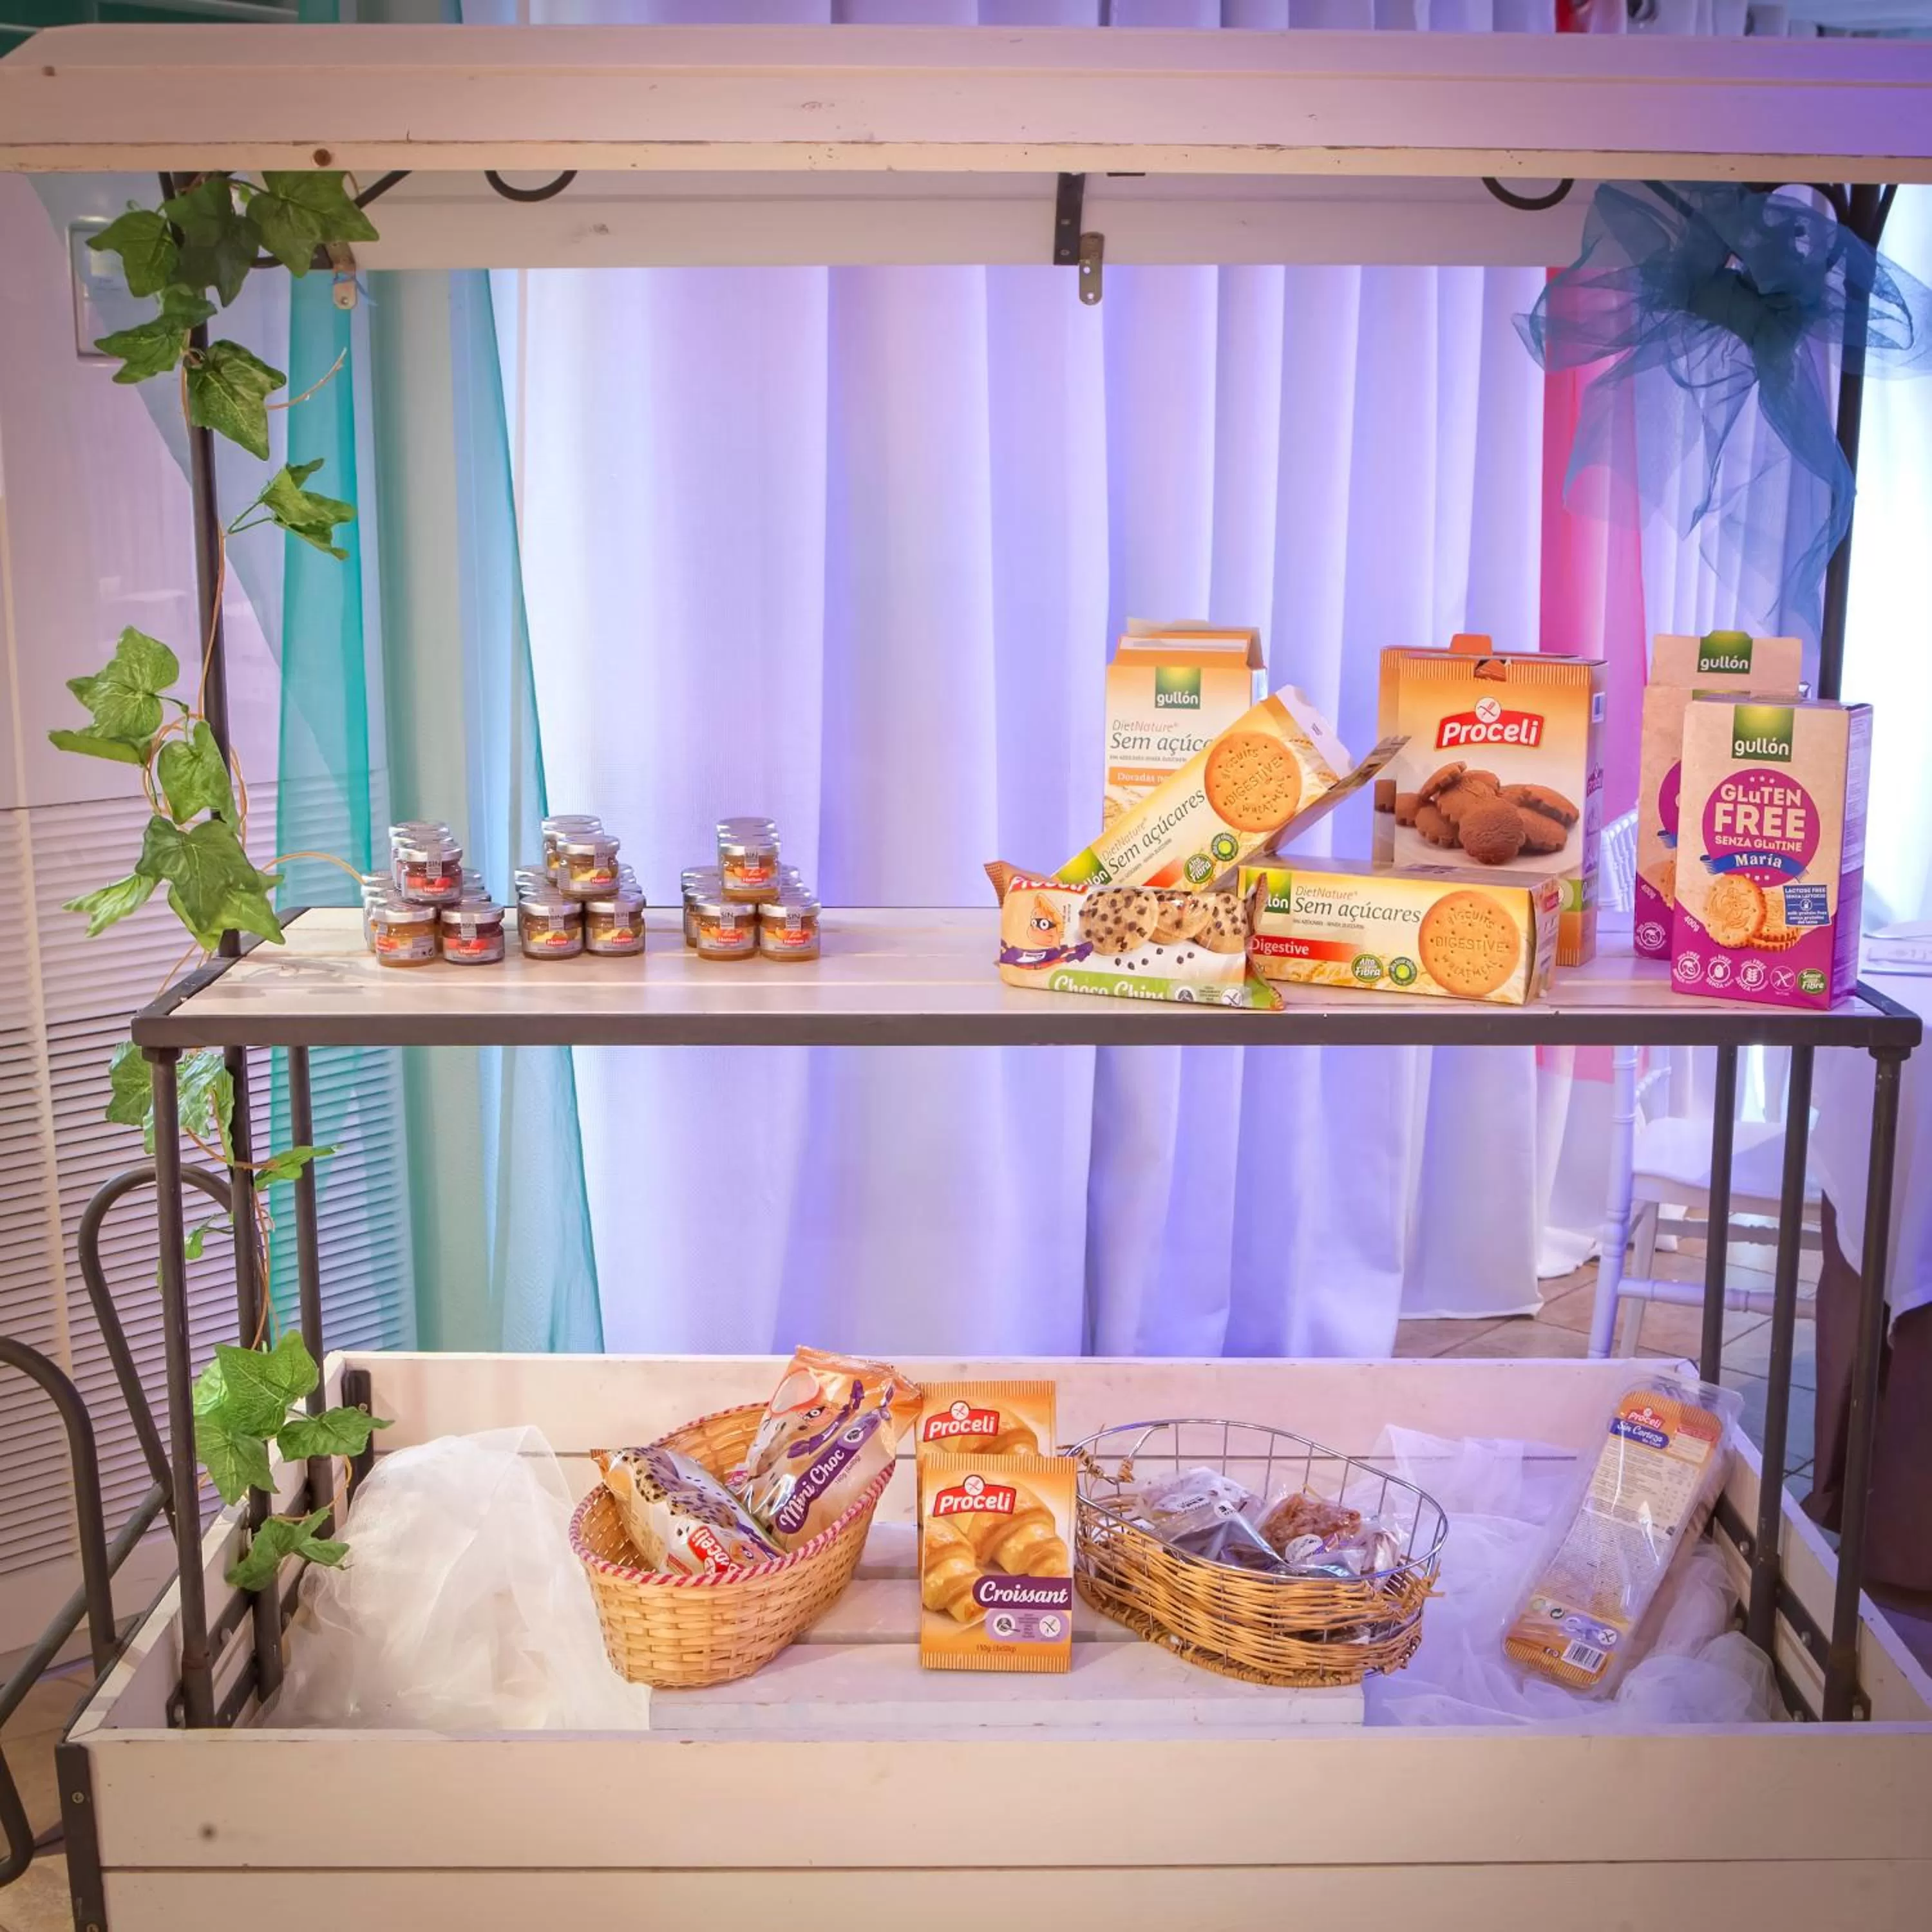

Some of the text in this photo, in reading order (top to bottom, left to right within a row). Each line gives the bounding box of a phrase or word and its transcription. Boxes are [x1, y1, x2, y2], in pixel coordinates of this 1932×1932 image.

[1700, 655, 1748, 670] gullón
[1157, 691, 1198, 706] gullón
[1442, 719, 1539, 746] Proceli
[1110, 733, 1209, 756] Sem açúc
[1734, 737, 1790, 756] gullón
[1226, 757, 1282, 806] DIGESTIVE
[1714, 802, 1806, 839] FREE
[1108, 844, 1141, 875] Sem
[1142, 790, 1205, 848] açúcares
[1715, 835, 1752, 848] SENZA
[1735, 853, 1782, 869] María
[1083, 871, 1108, 885] lón
[1264, 895, 1289, 908] lón
[1293, 898, 1422, 923] Sem açúcares
[1249, 938, 1309, 956] Digestive
[1435, 936, 1505, 952] DIGESTIVE
[929, 1415, 994, 1439] Proceli
[779, 1450, 844, 1528] Mini Choc
[940, 1493, 1011, 1514] Proceli
[979, 1581, 1068, 1605] Croissant
